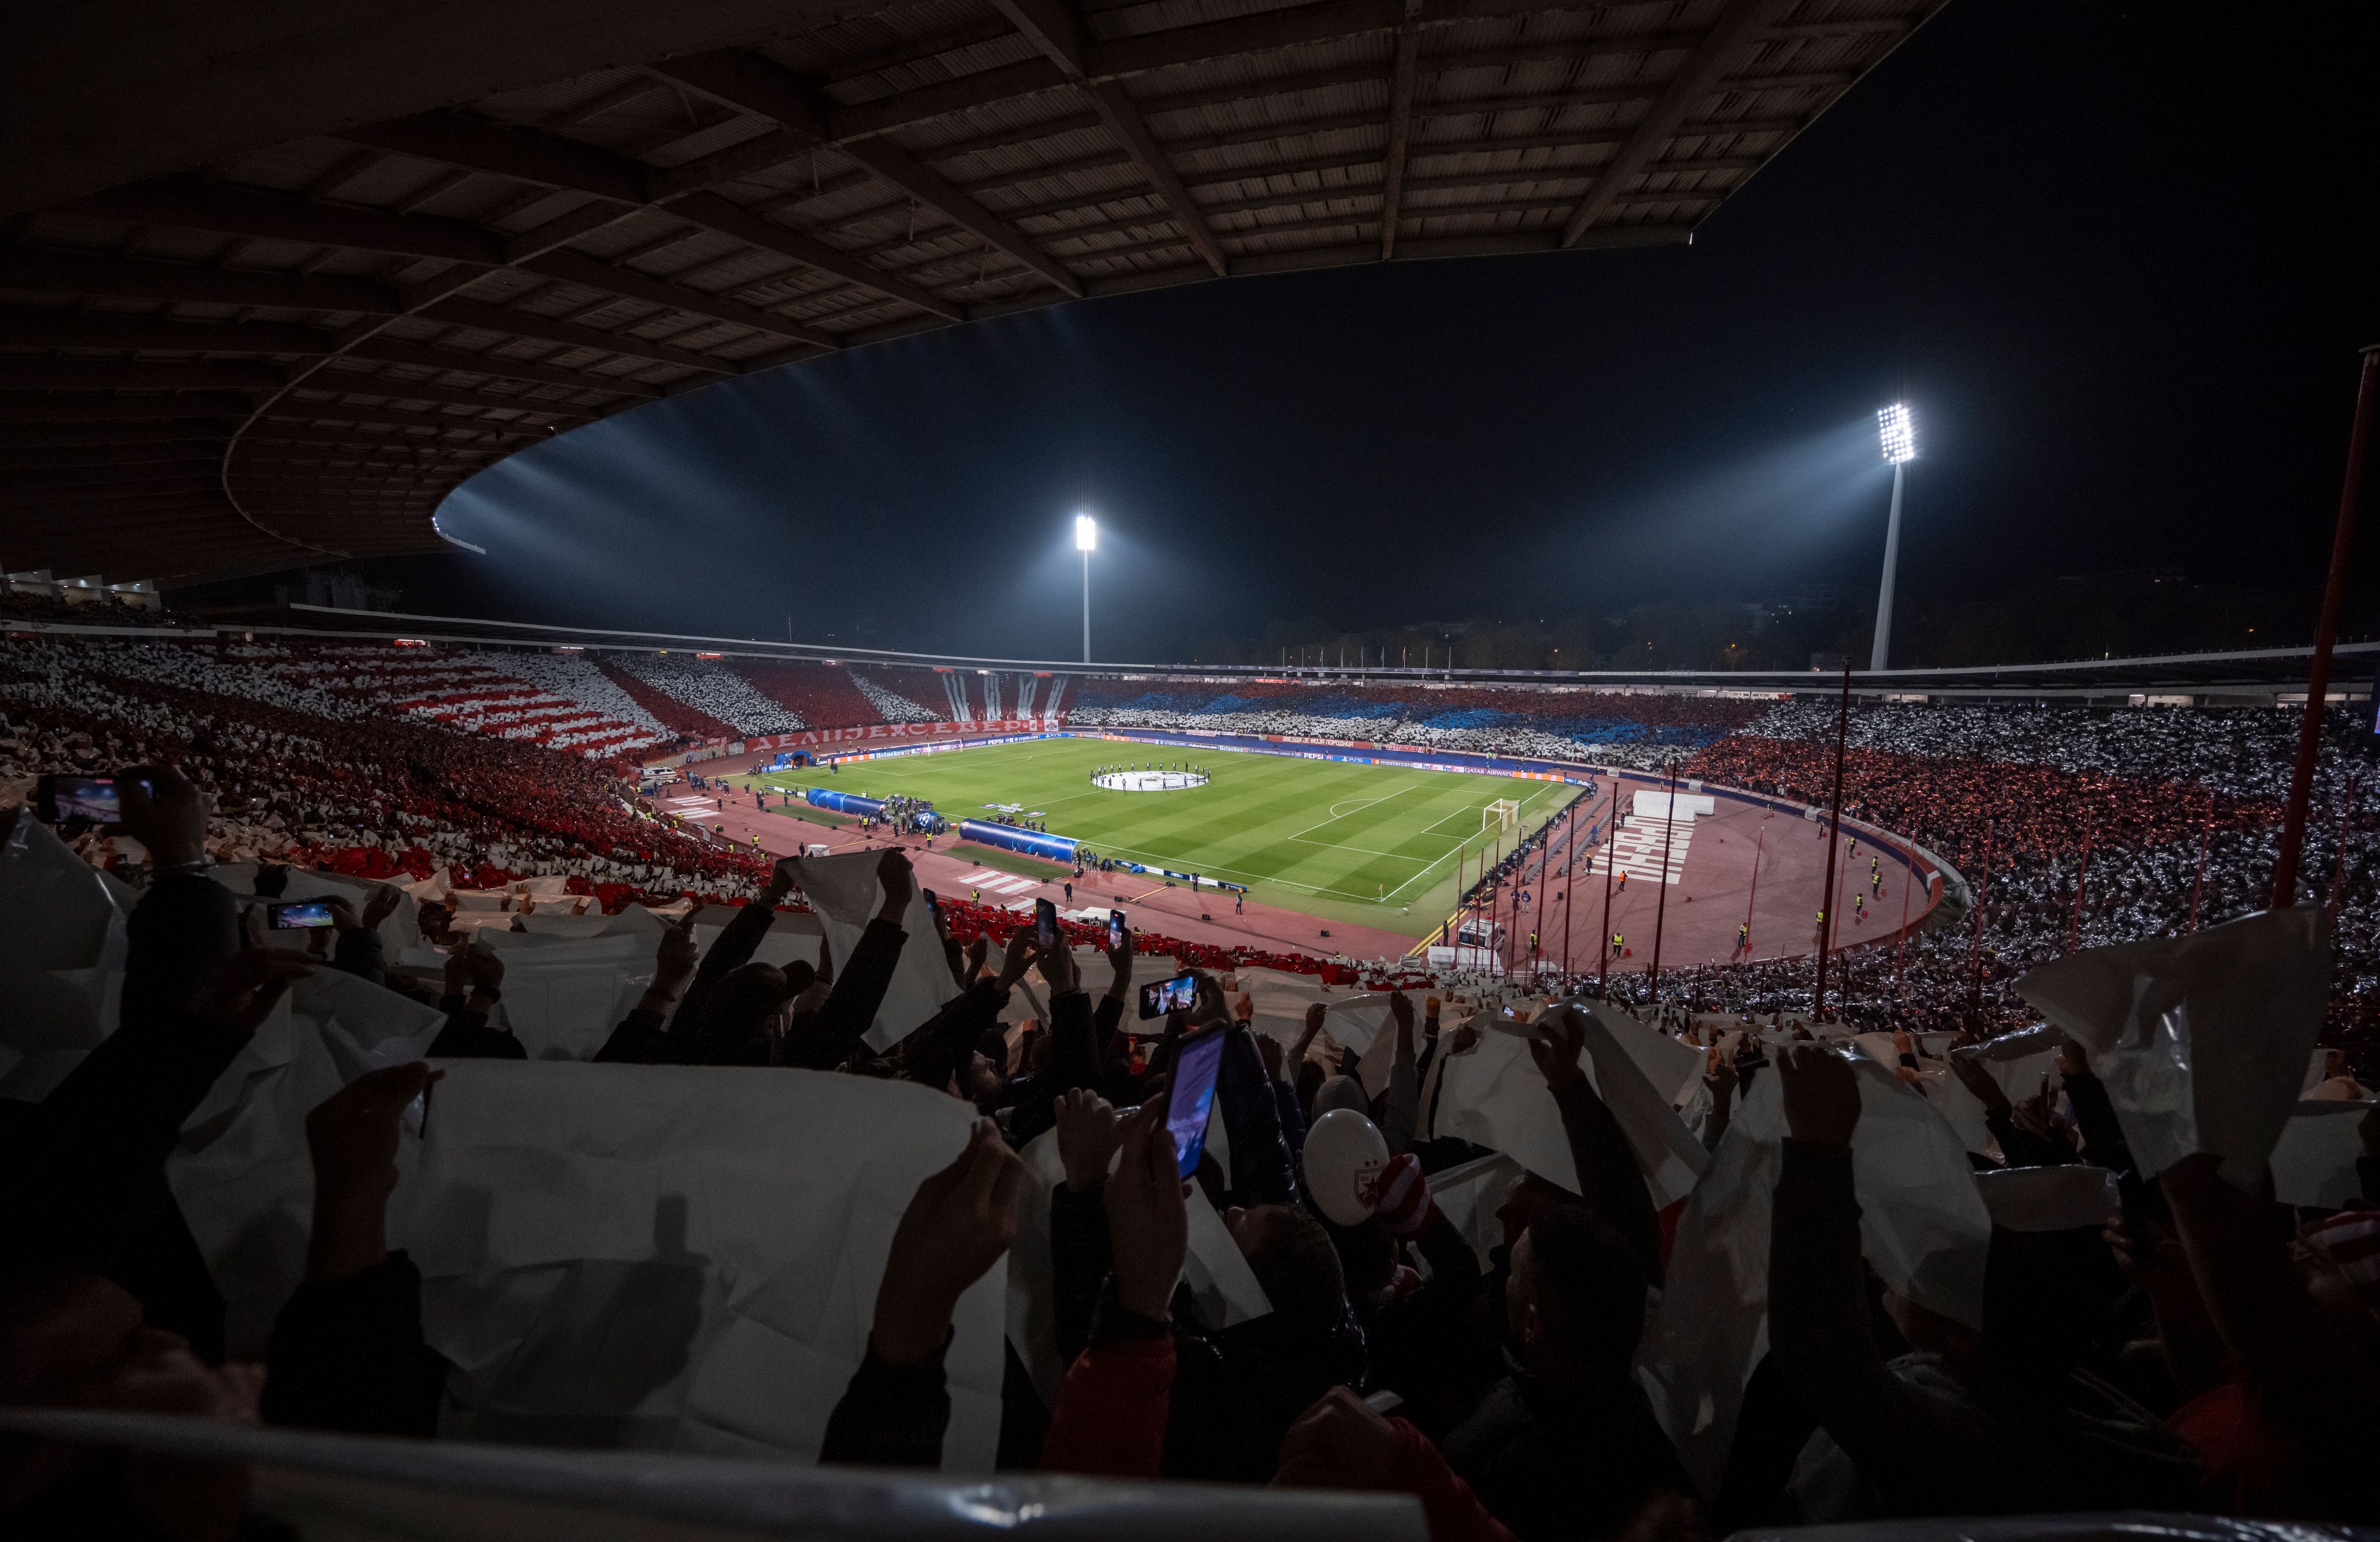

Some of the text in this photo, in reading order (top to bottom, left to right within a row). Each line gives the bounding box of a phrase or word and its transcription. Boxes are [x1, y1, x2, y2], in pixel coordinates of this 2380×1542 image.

[908, 721, 1022, 736] СЕВЕР
[1326, 739, 1354, 747] ПОРОДИЦА
[876, 749, 904, 759] Heineken
